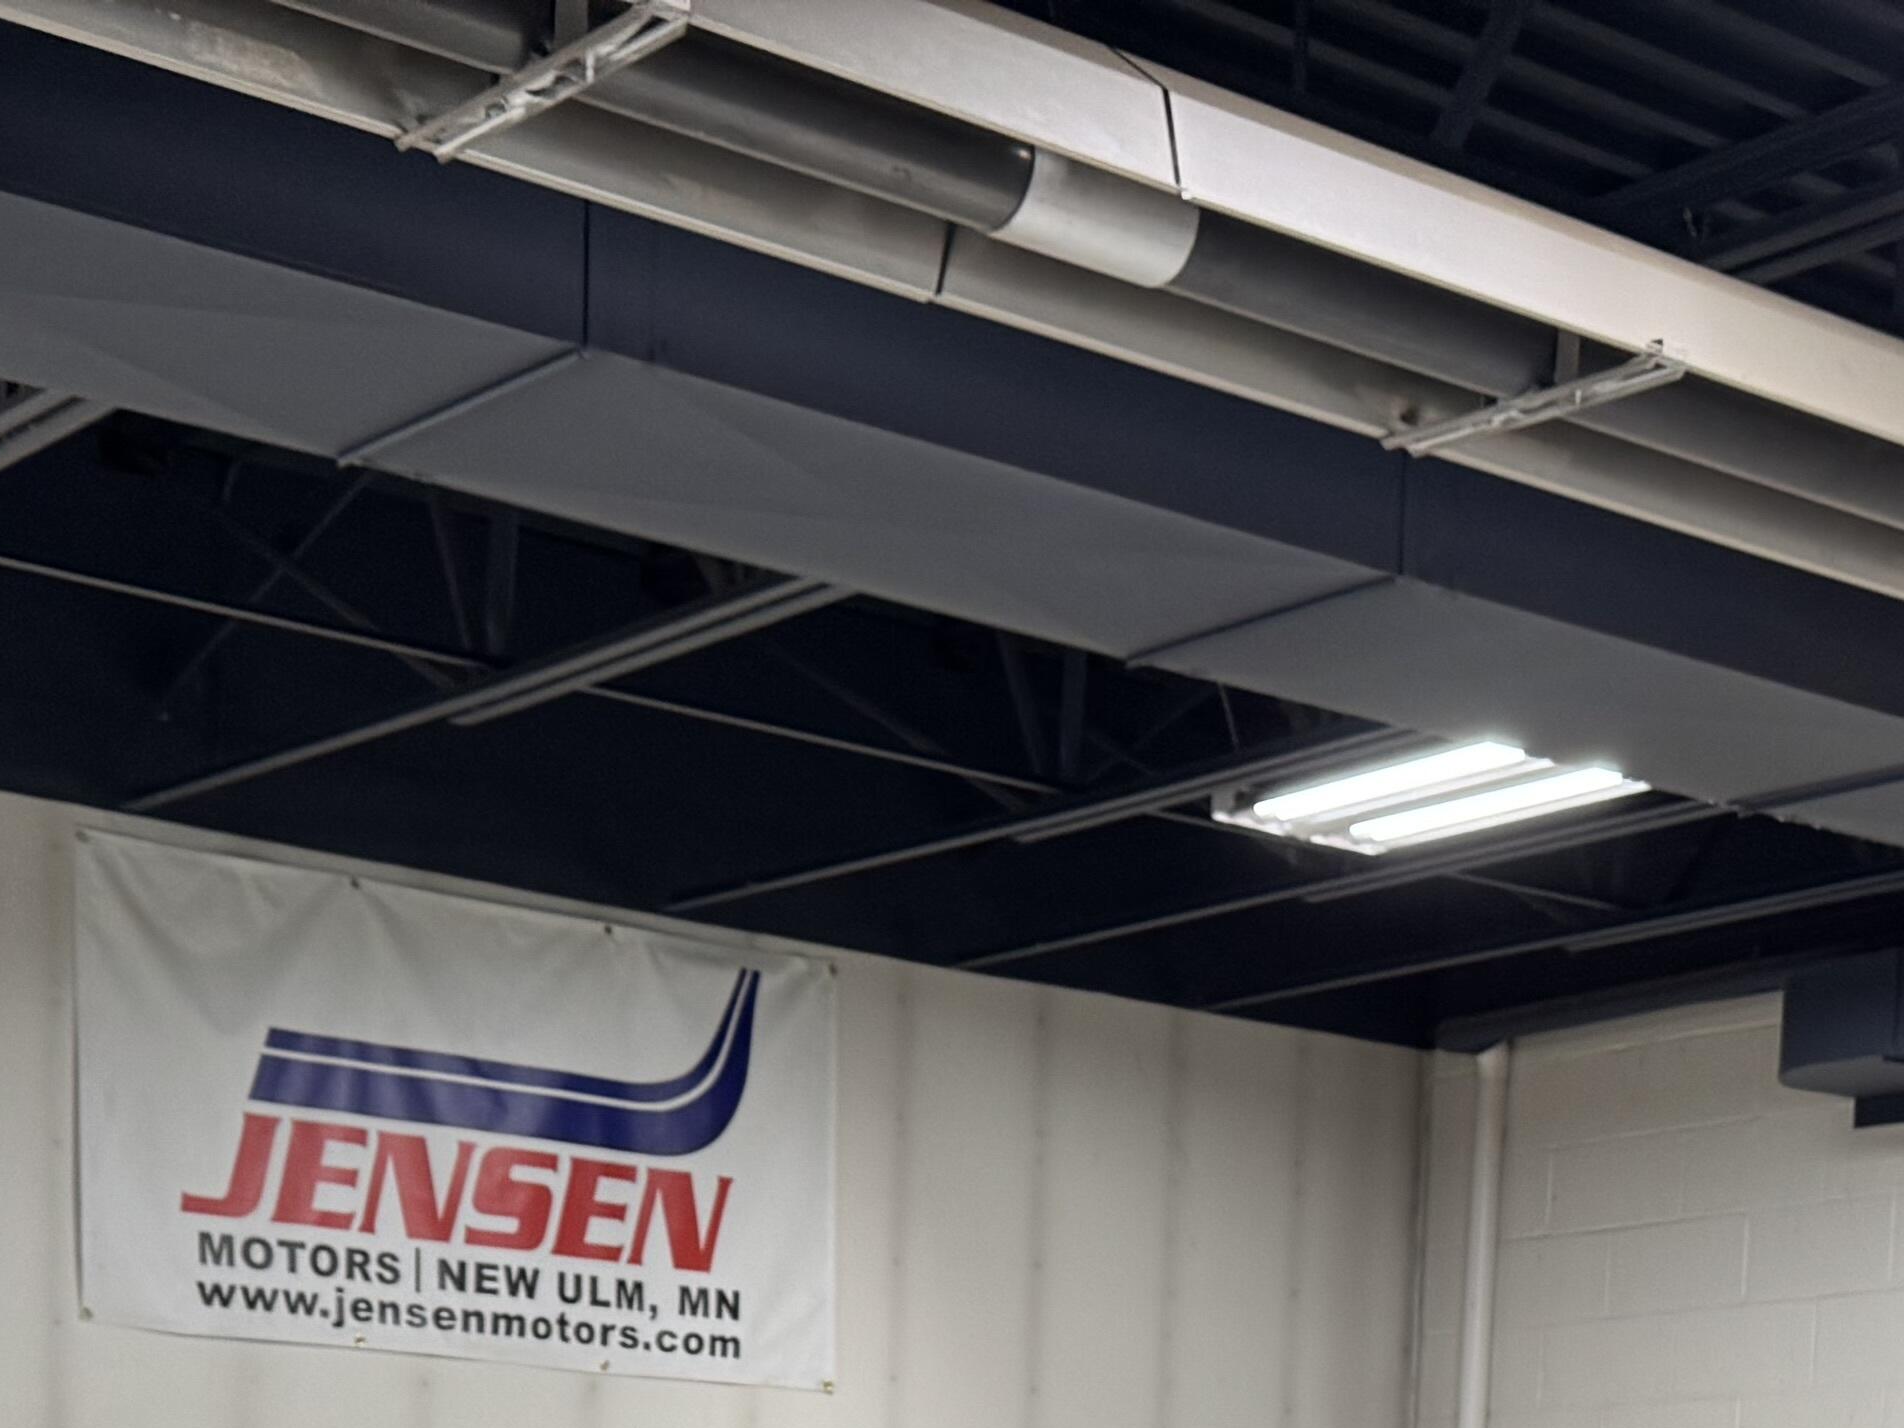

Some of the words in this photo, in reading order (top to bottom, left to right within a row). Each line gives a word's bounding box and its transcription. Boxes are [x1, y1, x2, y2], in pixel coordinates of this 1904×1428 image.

[179, 1110, 734, 1273] JENSEN
[196, 1280, 741, 1360] www.jensenmotors.com
[197, 1231, 401, 1285] MOTORS
[437, 1257, 540, 1300] NEW
[556, 1271, 658, 1322] ULM,
[677, 1285, 742, 1321] MN
